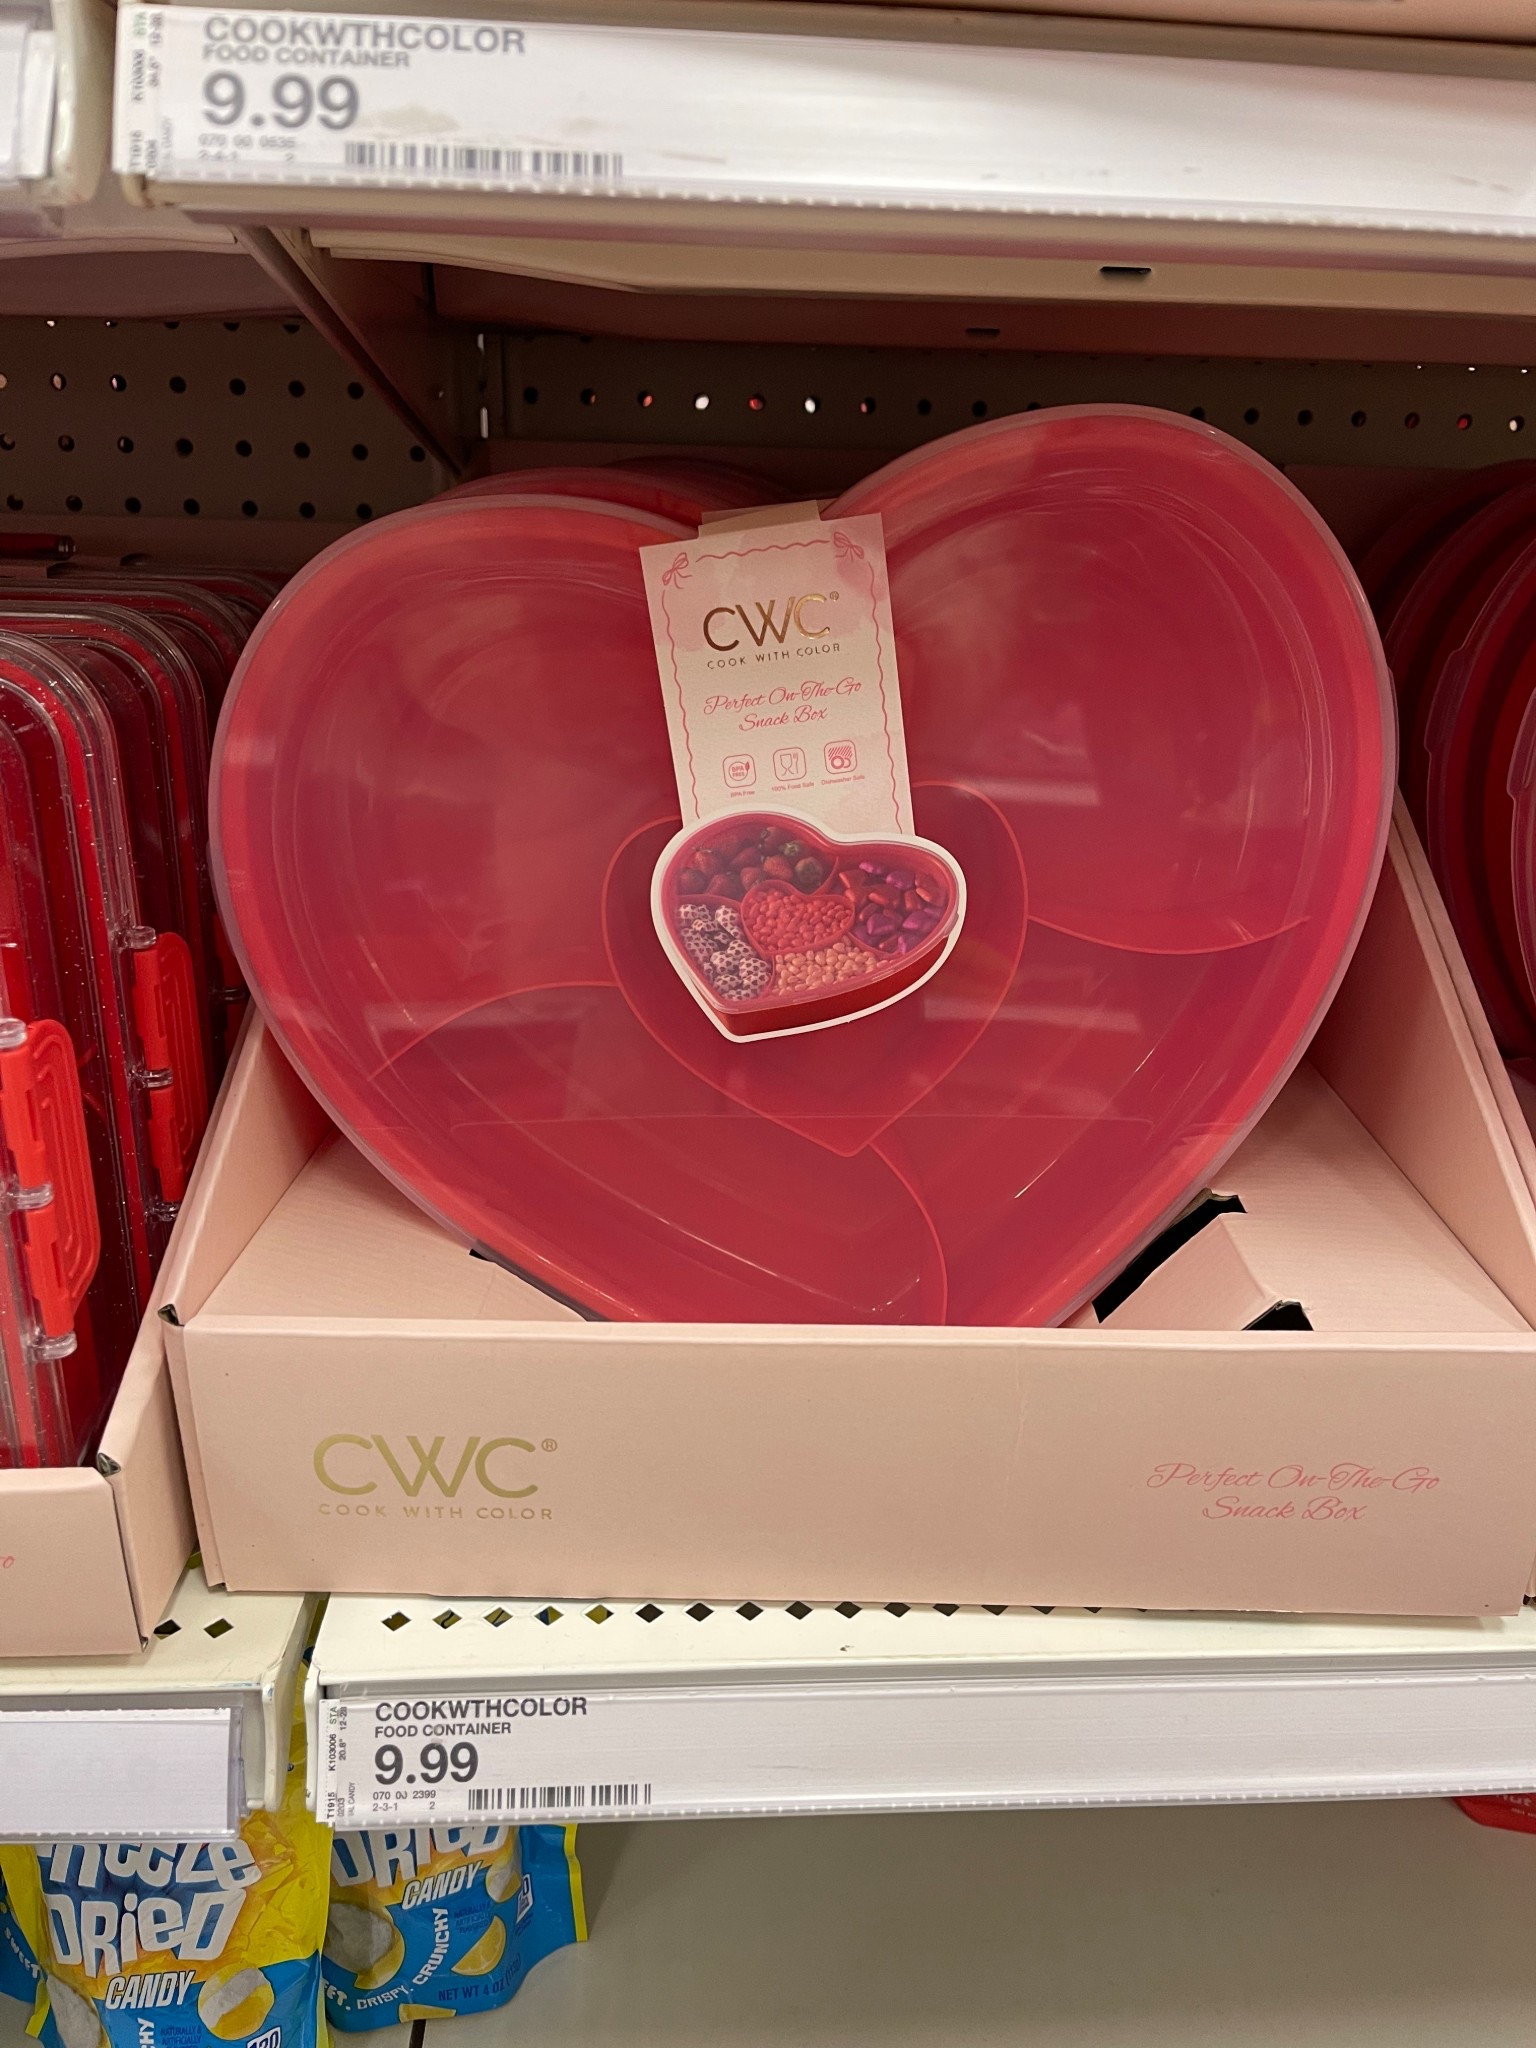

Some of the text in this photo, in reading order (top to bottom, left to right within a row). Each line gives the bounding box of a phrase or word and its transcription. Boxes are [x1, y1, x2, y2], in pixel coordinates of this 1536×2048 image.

[205, 16, 525, 54] COOKWTHCOLOR
[204, 46, 410, 69] FOOD CONTAINER
[203, 71, 359, 131] 9.99
[707, 643, 840, 669] COOK WITH COLOR
[703, 677, 862, 715] Perfect On-The-Go
[738, 704, 828, 731] Snack Box
[1147, 1462, 1441, 1493] Perfect On-The-Go
[318, 1503, 553, 1520] COOK WITH COLOR
[1202, 1496, 1368, 1521] Snack Box
[329, 1706, 338, 1725] STA
[375, 1696, 588, 1722] COOKWTHCOLOR
[374, 1722, 512, 1738] FOOD CONTAINER
[328, 1733, 337, 1772] K103006
[374, 1741, 479, 1786] 9.99
[326, 1792, 336, 1820] T1915
[348, 1782, 356, 1804] CANDY
[372, 1791, 391, 1800] 070
[412, 1789, 437, 1799] 2399
[372, 1801, 436, 1812] 2-3-1 2
[402, 1860, 484, 1910] CANDY
[412, 1908, 449, 1985] CRUNCHY
[105, 1970, 196, 2010] CANDY
[438, 1987, 459, 2001] NET
[462, 1984, 480, 1998] WT
[483, 1984, 489, 1996] 4
